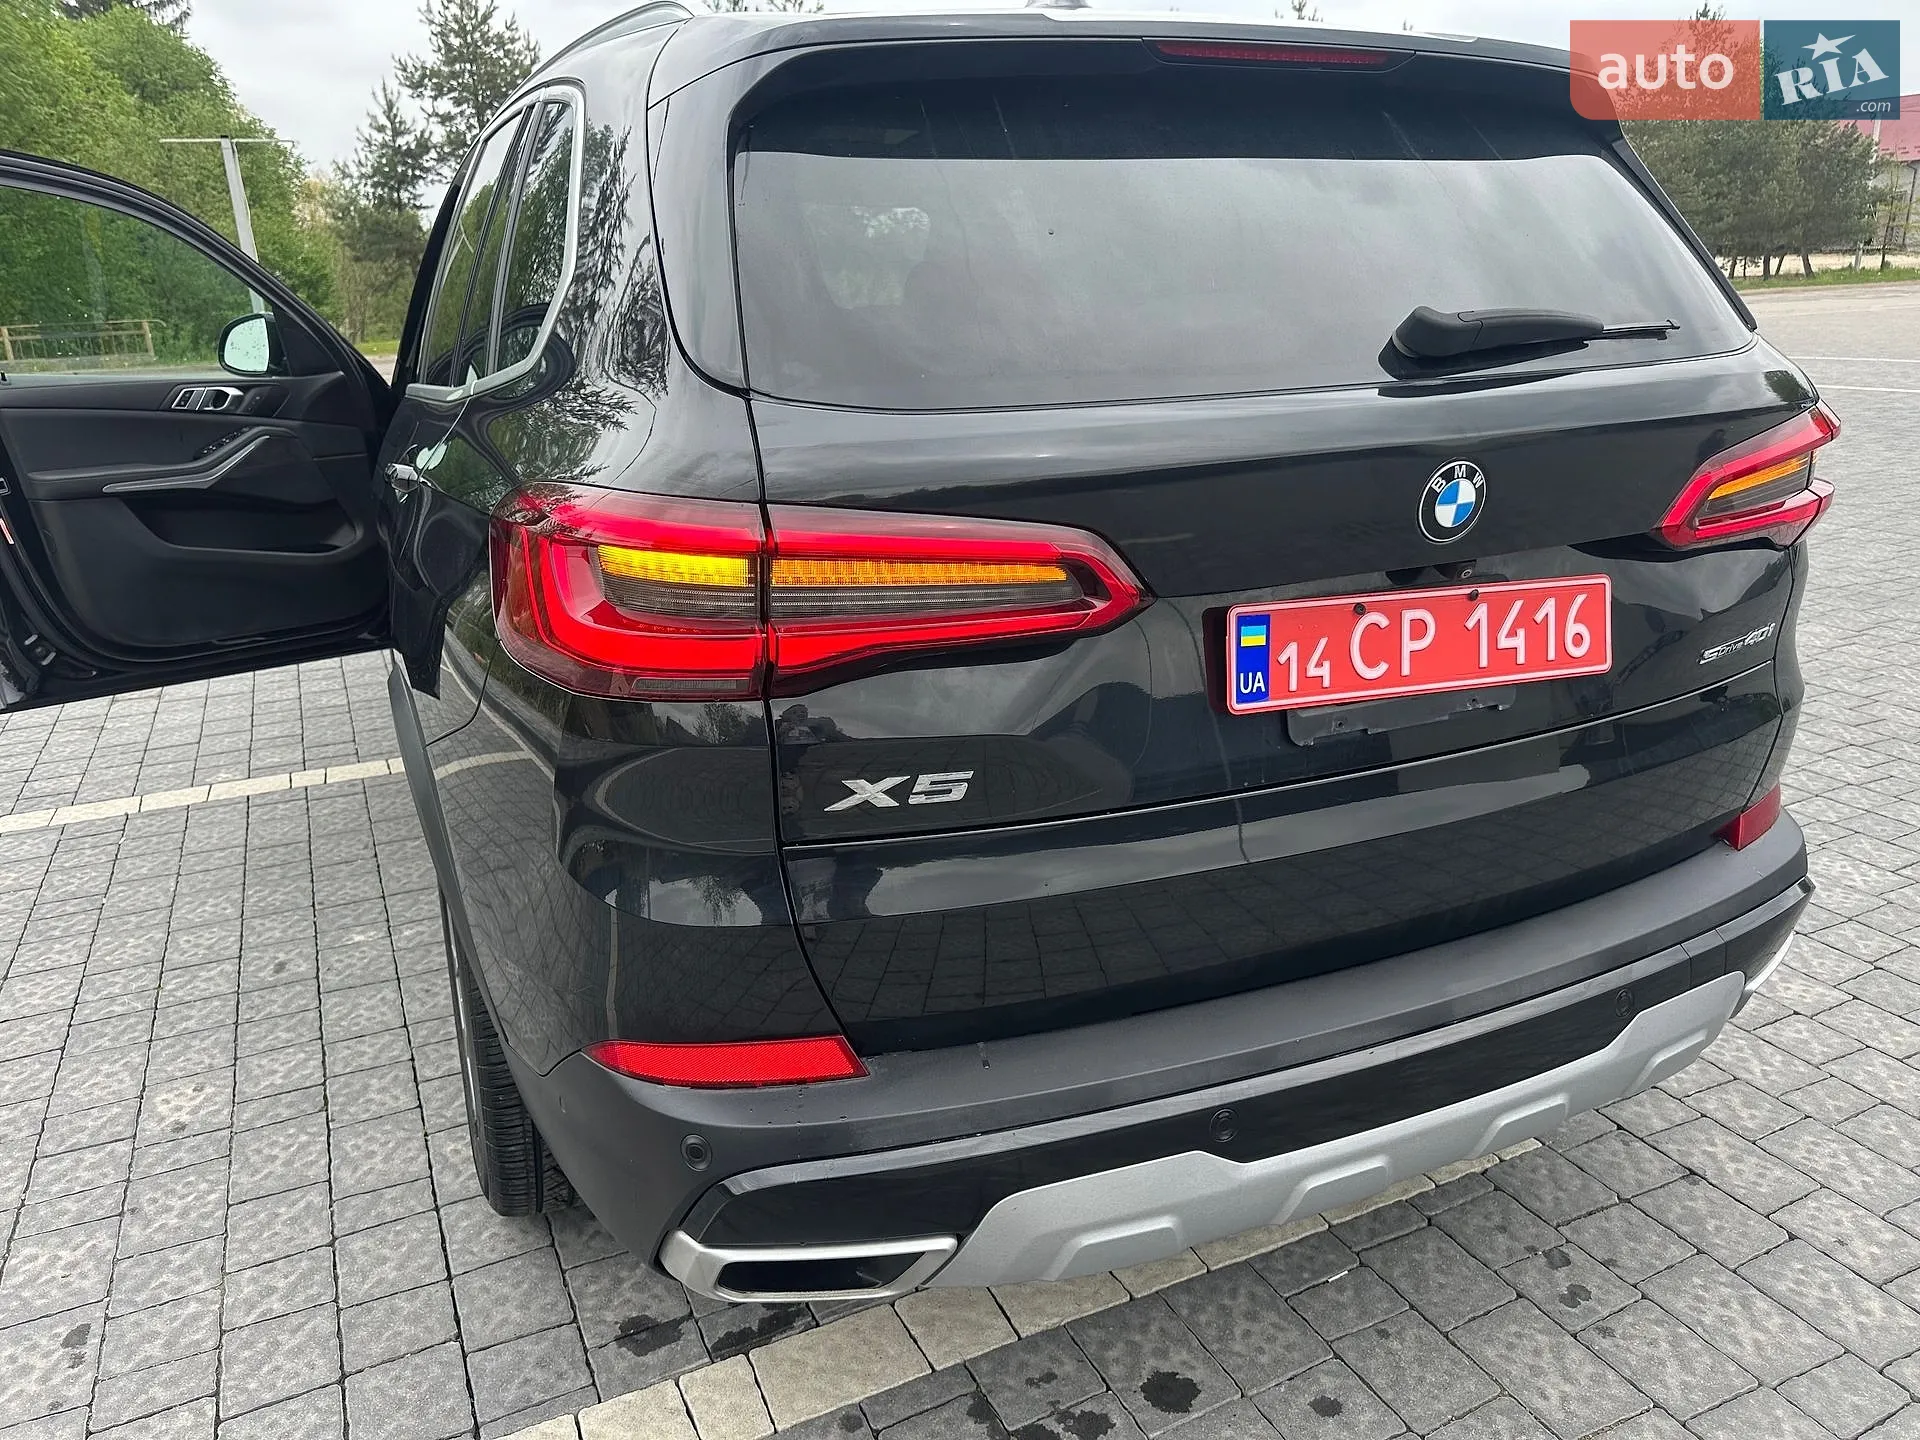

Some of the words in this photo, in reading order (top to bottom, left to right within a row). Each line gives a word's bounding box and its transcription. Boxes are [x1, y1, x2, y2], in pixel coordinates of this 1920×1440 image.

[1431, 464, 1485, 494] BMW
[1277, 636, 1331, 692] 14
[1463, 593, 1592, 669] 1416
[1240, 671, 1266, 694] UA
[823, 770, 975, 812] X5
